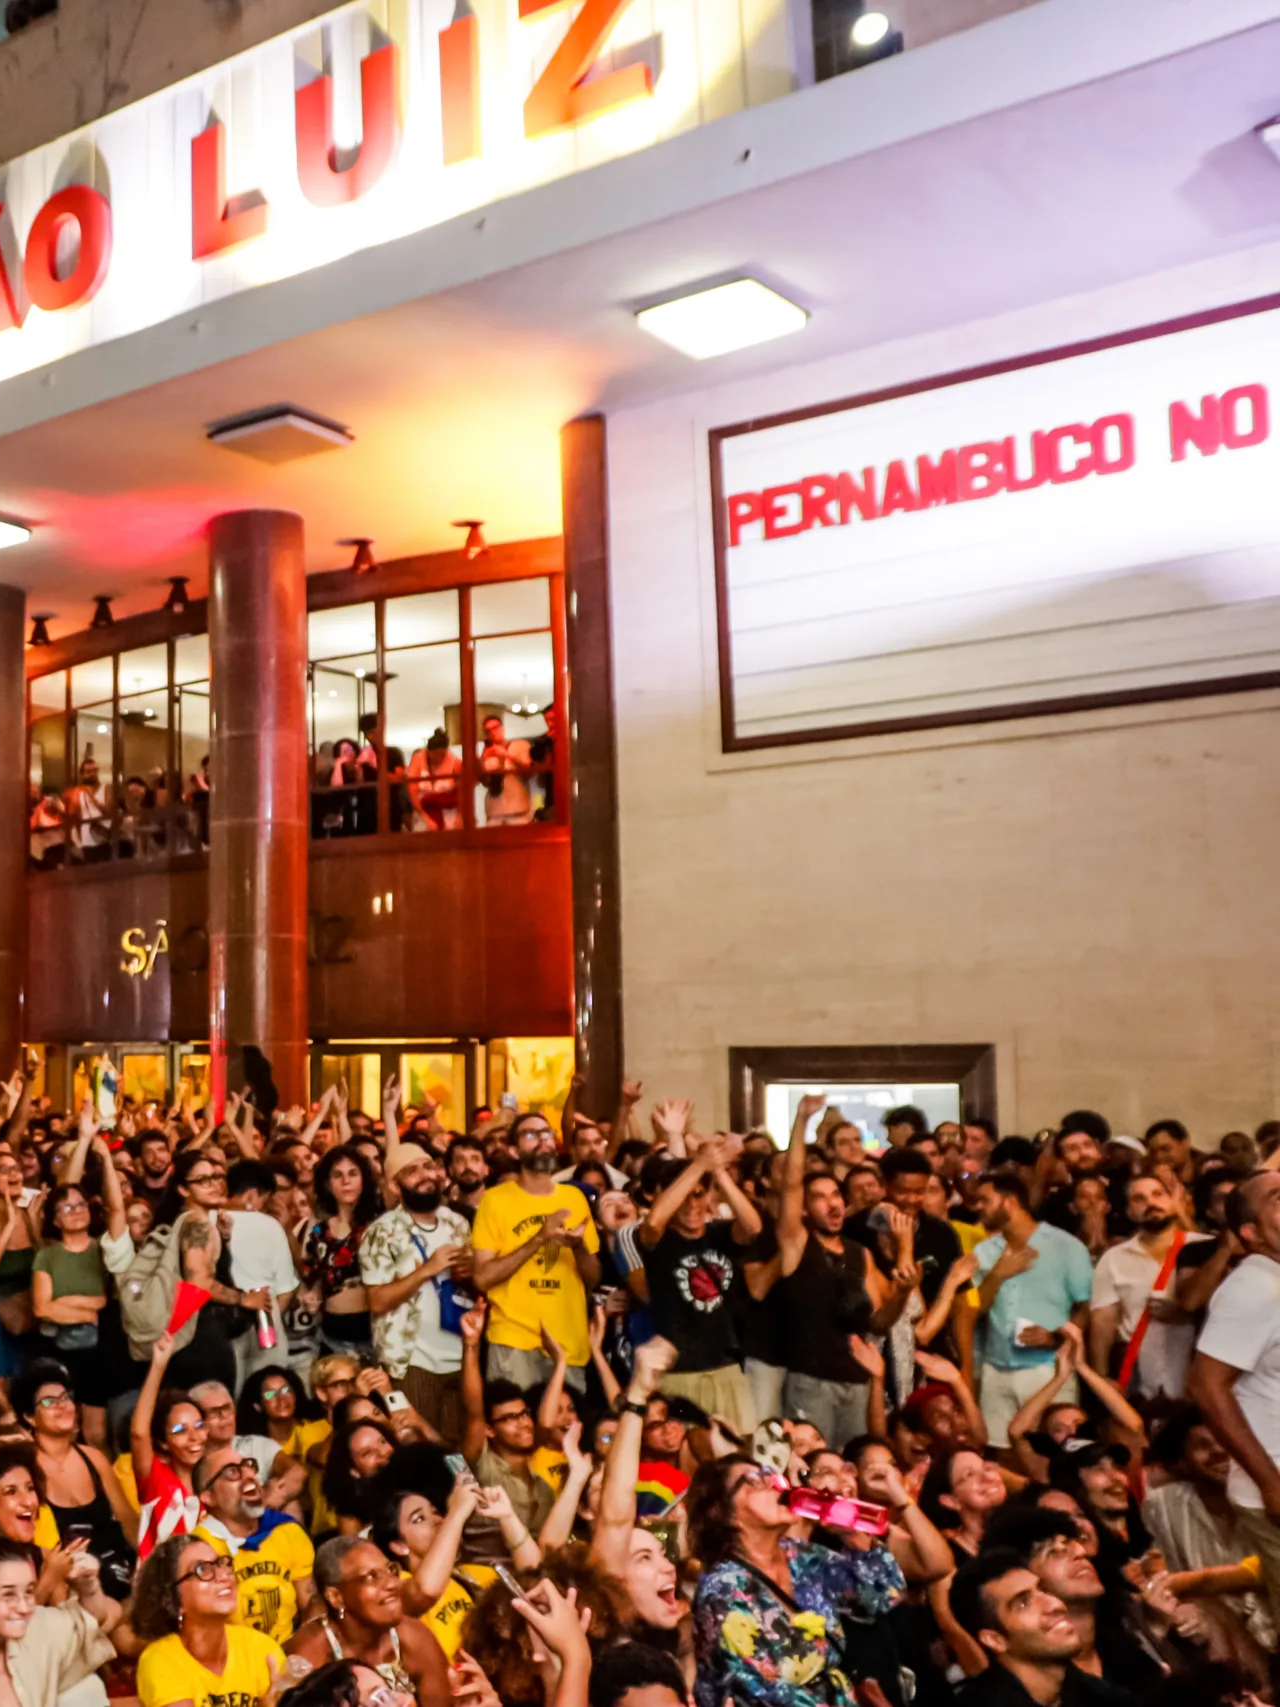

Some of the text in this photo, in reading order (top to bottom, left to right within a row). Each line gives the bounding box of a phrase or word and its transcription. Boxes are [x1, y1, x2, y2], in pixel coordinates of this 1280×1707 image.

[191, 0, 655, 263] LUIZ
[727, 382, 1271, 548] PERNAMBUCO NO
